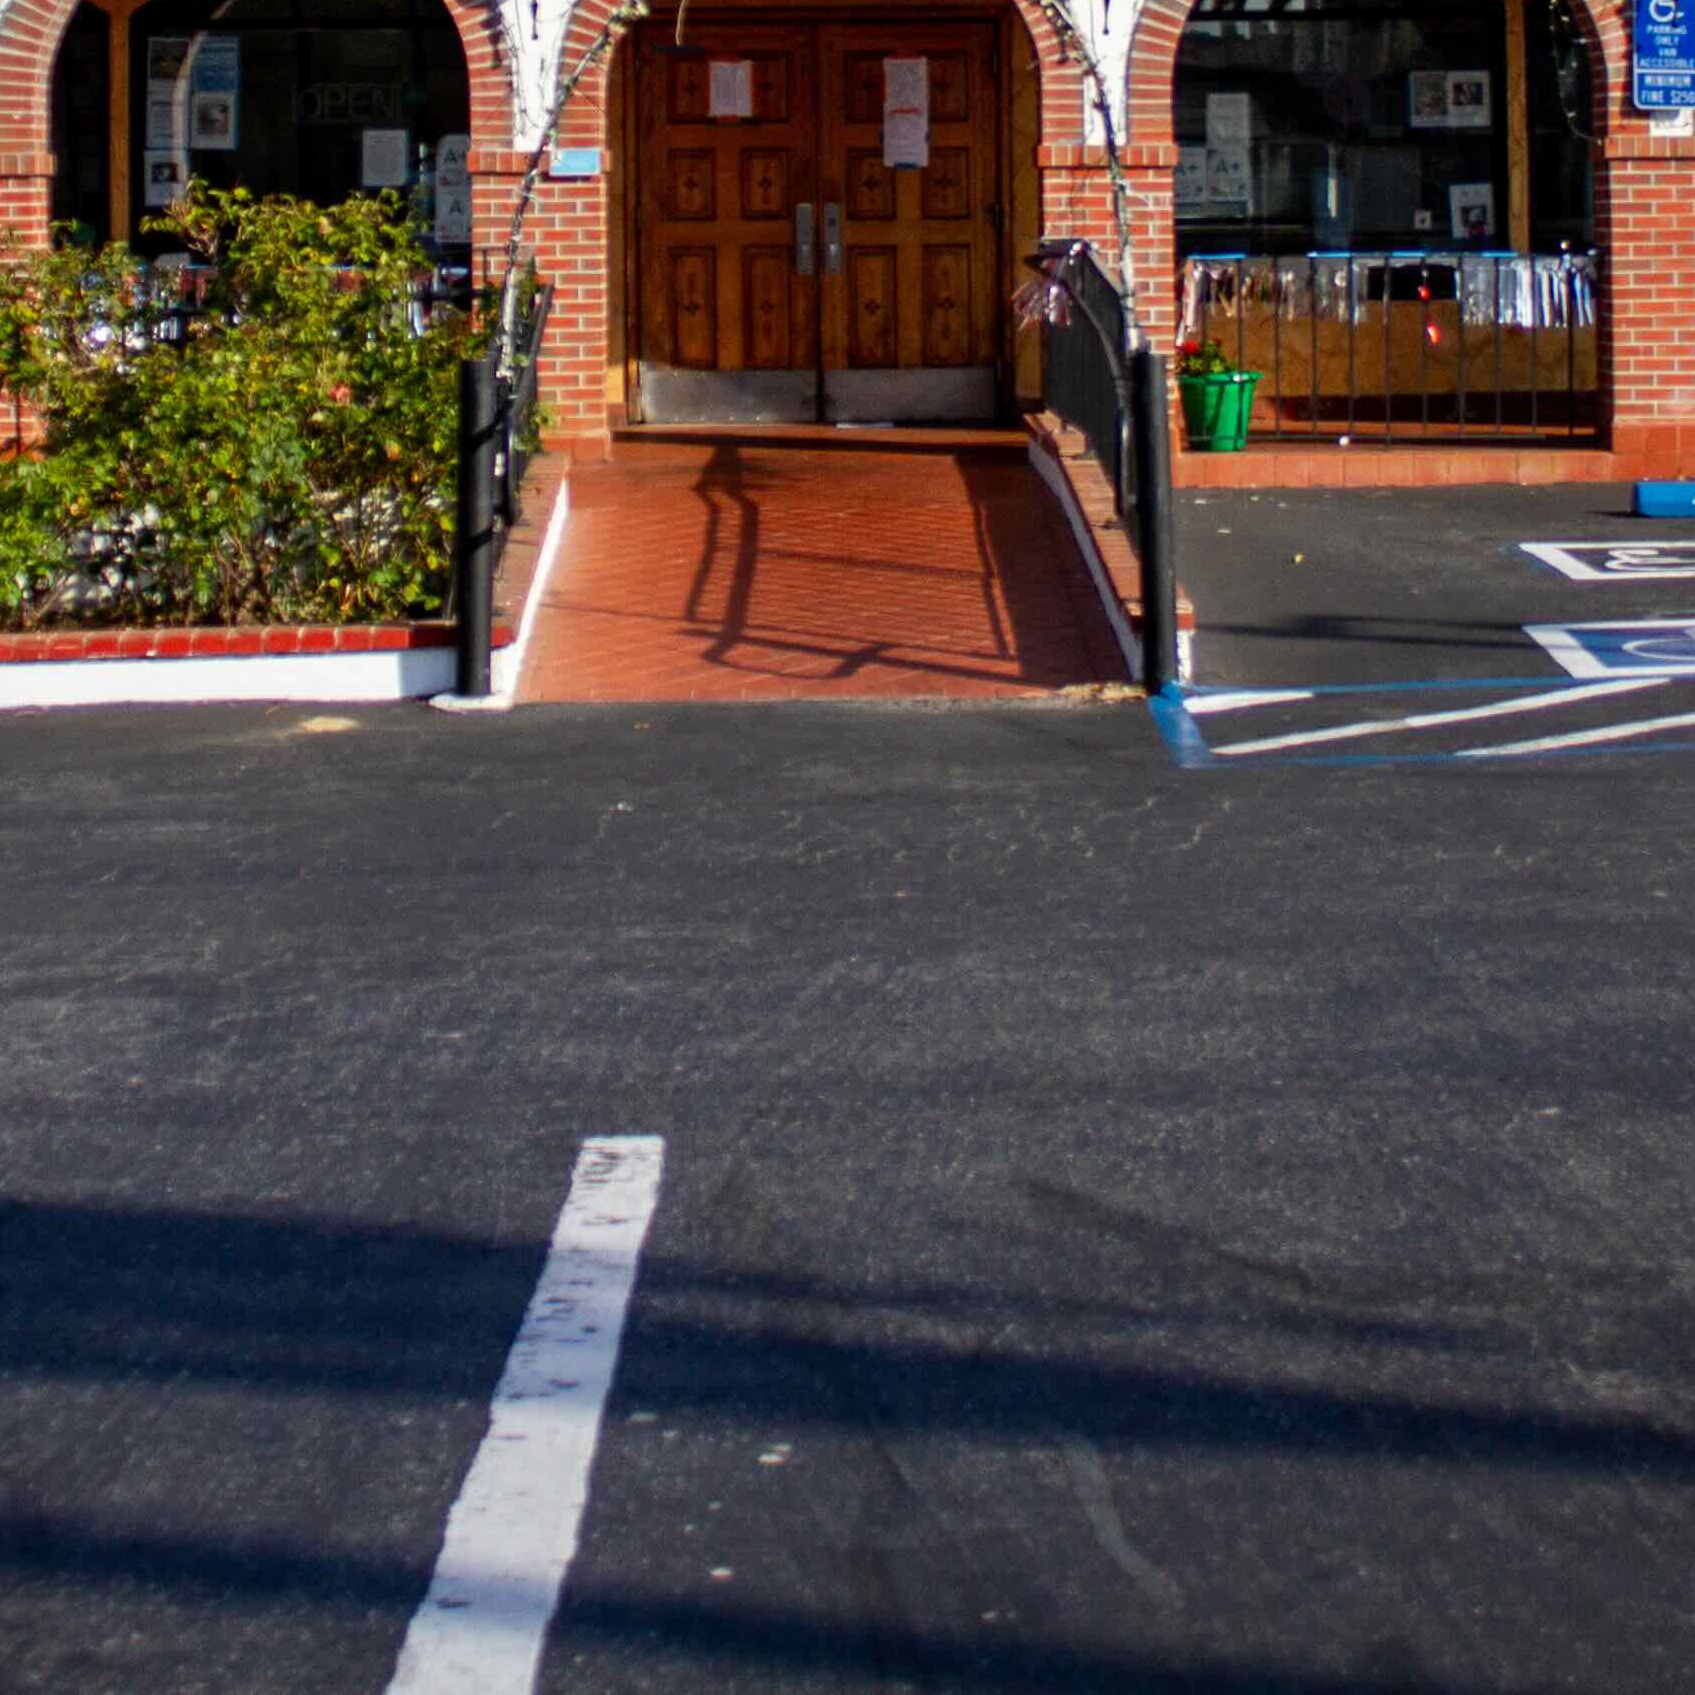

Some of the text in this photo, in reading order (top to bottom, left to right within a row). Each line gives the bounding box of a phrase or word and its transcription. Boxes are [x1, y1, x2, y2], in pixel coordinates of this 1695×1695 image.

[1645, 25, 1688, 35] PARKING
[1654, 35, 1680, 46] ONLY
[1657, 47, 1678, 57] VAN
[1639, 57, 1695, 69] ACCESSIBLE
[1644, 74, 1692, 88] MINIMUM
[1640, 89, 1665, 104] FINE
[298, 88, 398, 122] OPEN
